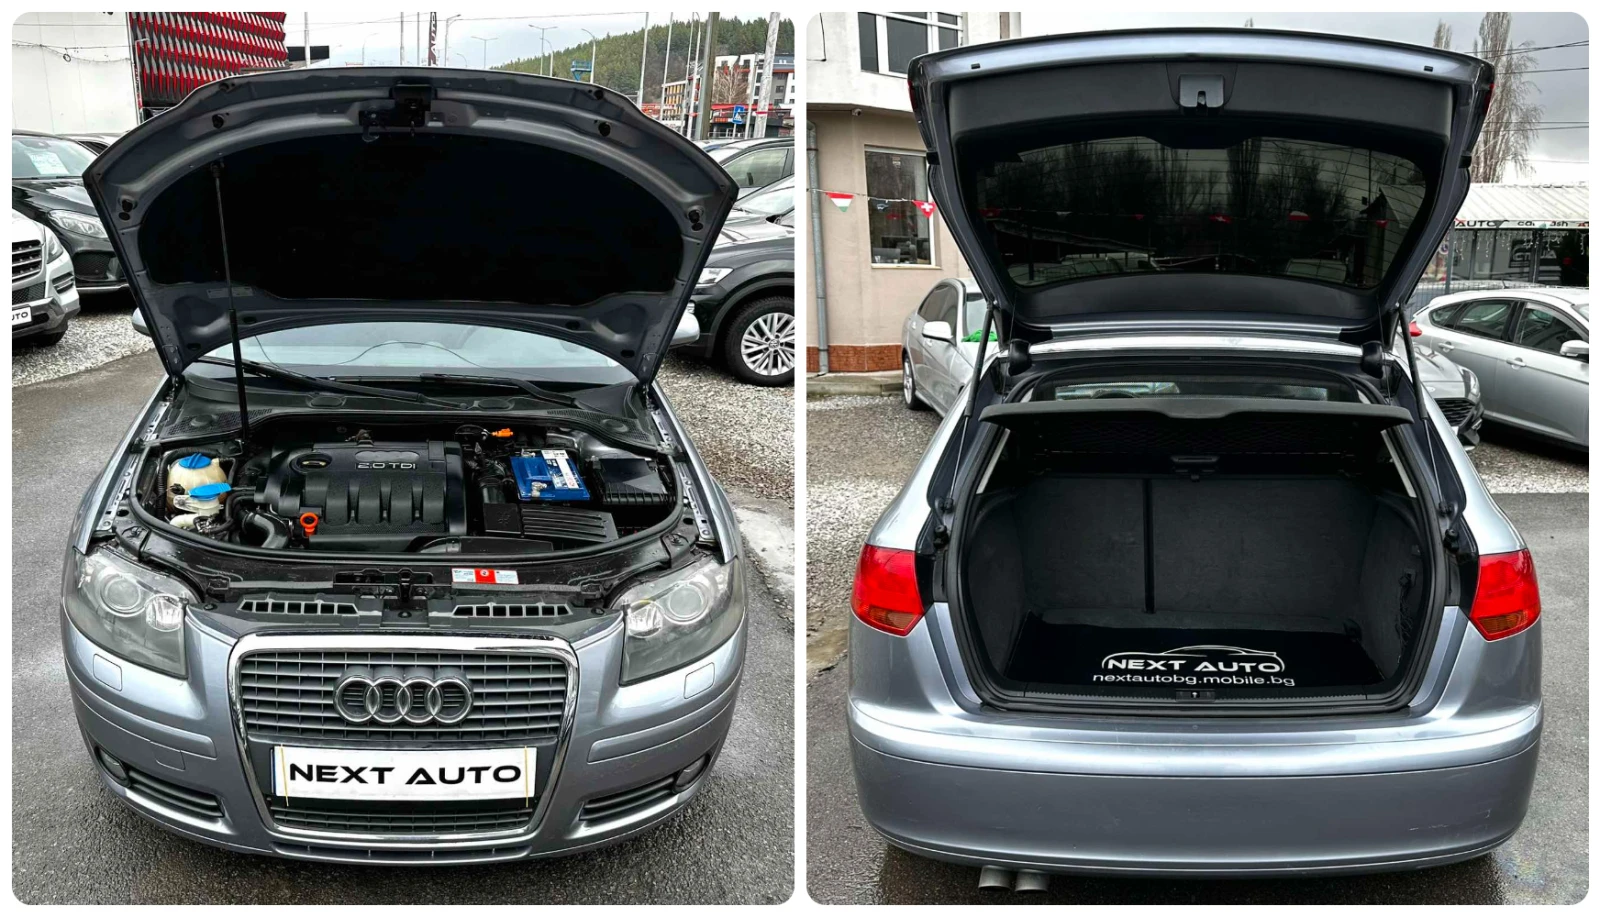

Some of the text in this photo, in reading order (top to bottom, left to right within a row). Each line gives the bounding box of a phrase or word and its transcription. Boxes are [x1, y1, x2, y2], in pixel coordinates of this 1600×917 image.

[1107, 659, 1281, 673] NEXT AUTO
[1093, 673, 1296, 687] nextautobg.mobile.bg
[289, 762, 522, 785] NEXT AUTO
